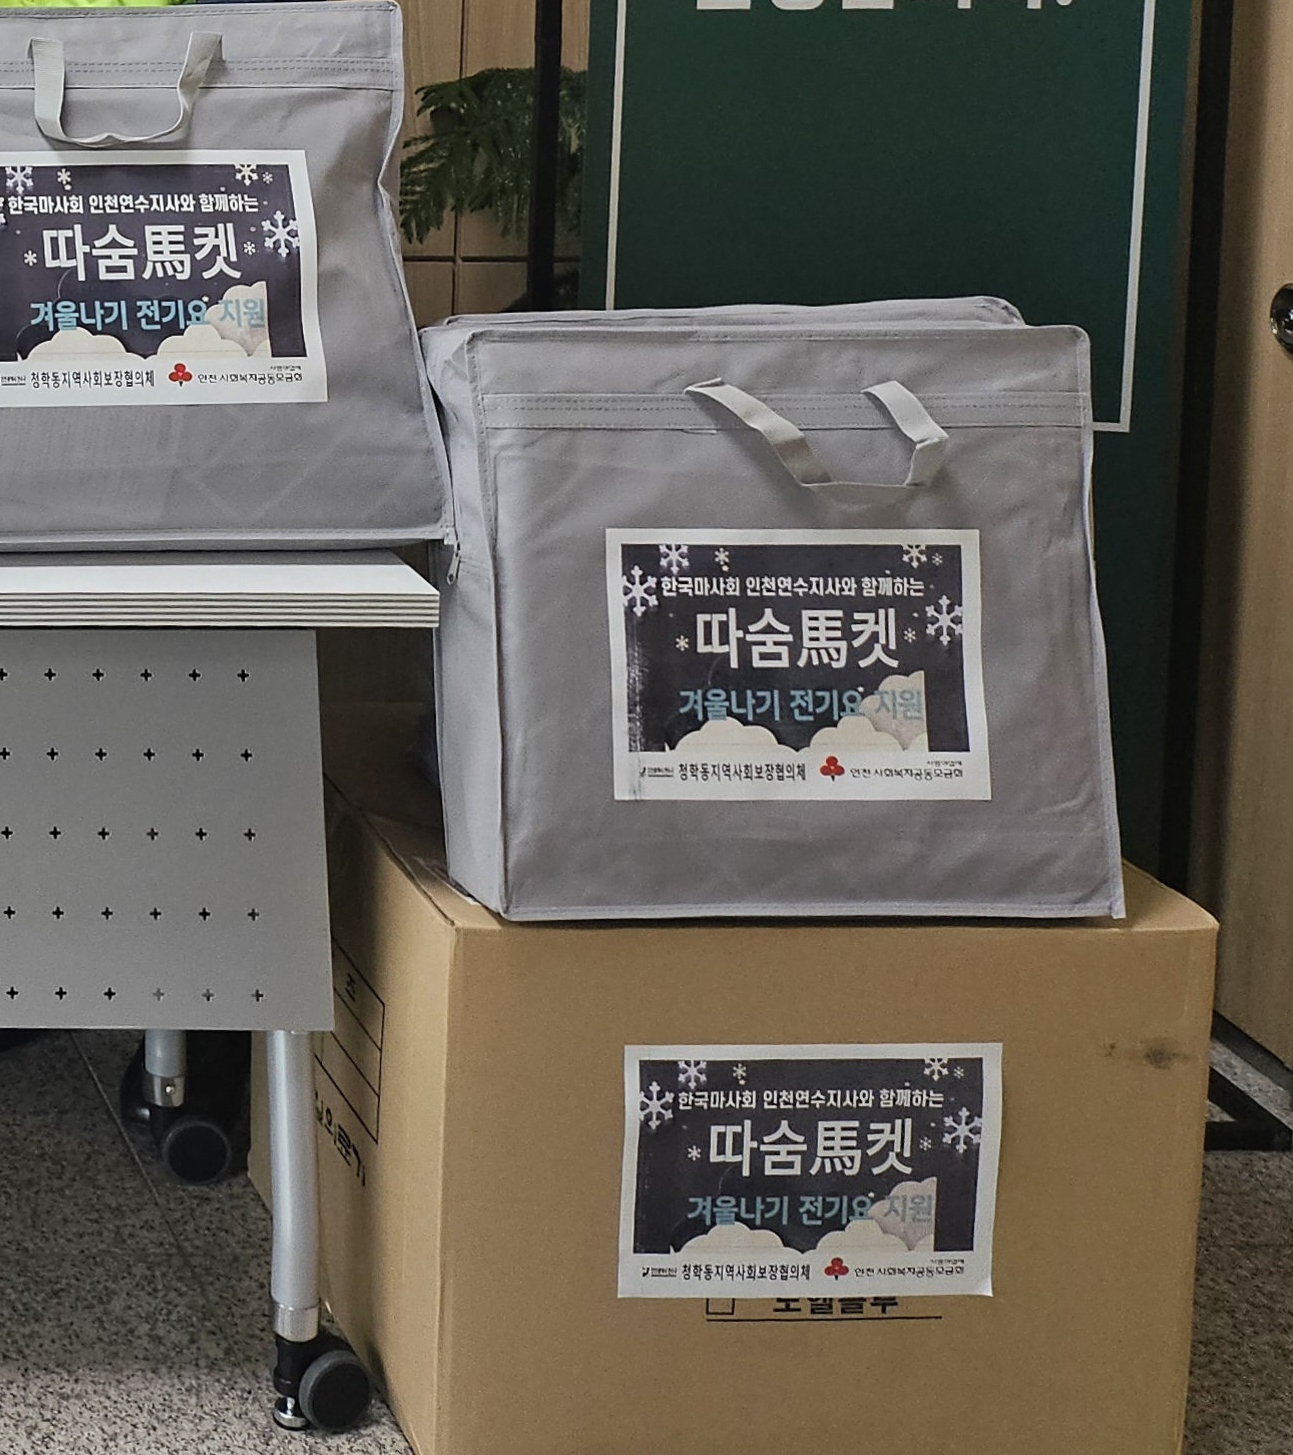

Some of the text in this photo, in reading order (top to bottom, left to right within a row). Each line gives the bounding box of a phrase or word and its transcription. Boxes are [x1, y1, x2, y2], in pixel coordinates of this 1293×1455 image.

[7, 193, 259, 215] 한국마사회 인천연수지사와 함께하는
[42, 222, 242, 282] 따숨馬켓
[29, 298, 266, 332] 겨울나기 전기요 지원
[661, 576, 925, 597] 한국마사회 인천연수지사와 함께하는
[695, 607, 899, 670] 따숨馬켓
[679, 689, 924, 721] 겨울나기 전기요 지원
[678, 1088, 944, 1110] 한국마사회 인천연수지사와 함께하는
[708, 1118, 913, 1177] 따숨馬켓
[686, 1194, 933, 1227] 겨울나기 전기요 지원
